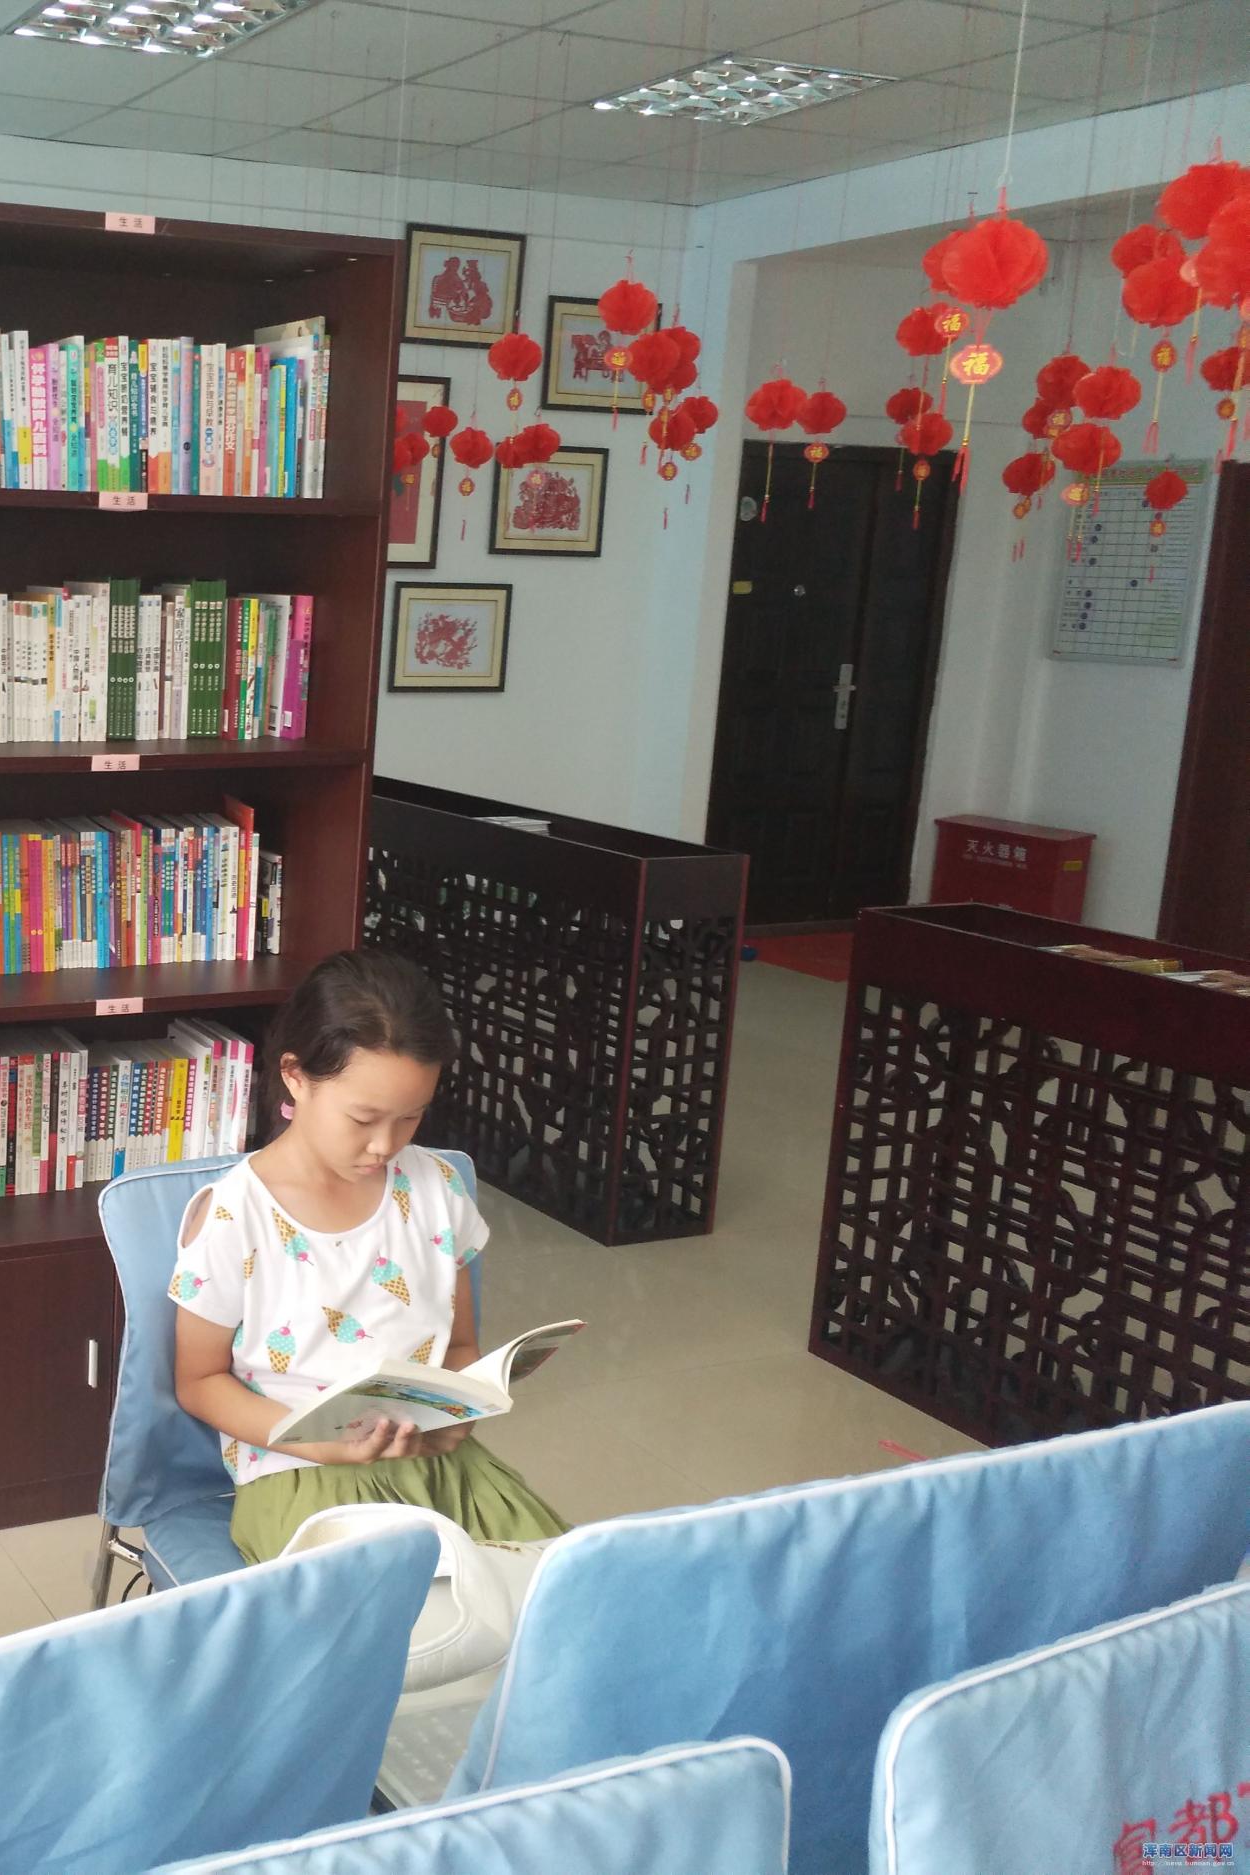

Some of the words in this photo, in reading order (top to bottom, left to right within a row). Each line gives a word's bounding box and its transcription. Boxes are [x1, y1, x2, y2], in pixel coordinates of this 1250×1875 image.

[119, 217, 143, 228] 生活
[942, 314, 961, 332] 福
[962, 352, 990, 376] 福
[112, 496, 136, 506] 生活
[104, 760, 127, 770] 生活
[966, 839, 1027, 862] 灭火器箱
[108, 1004, 130, 1014] 生活
